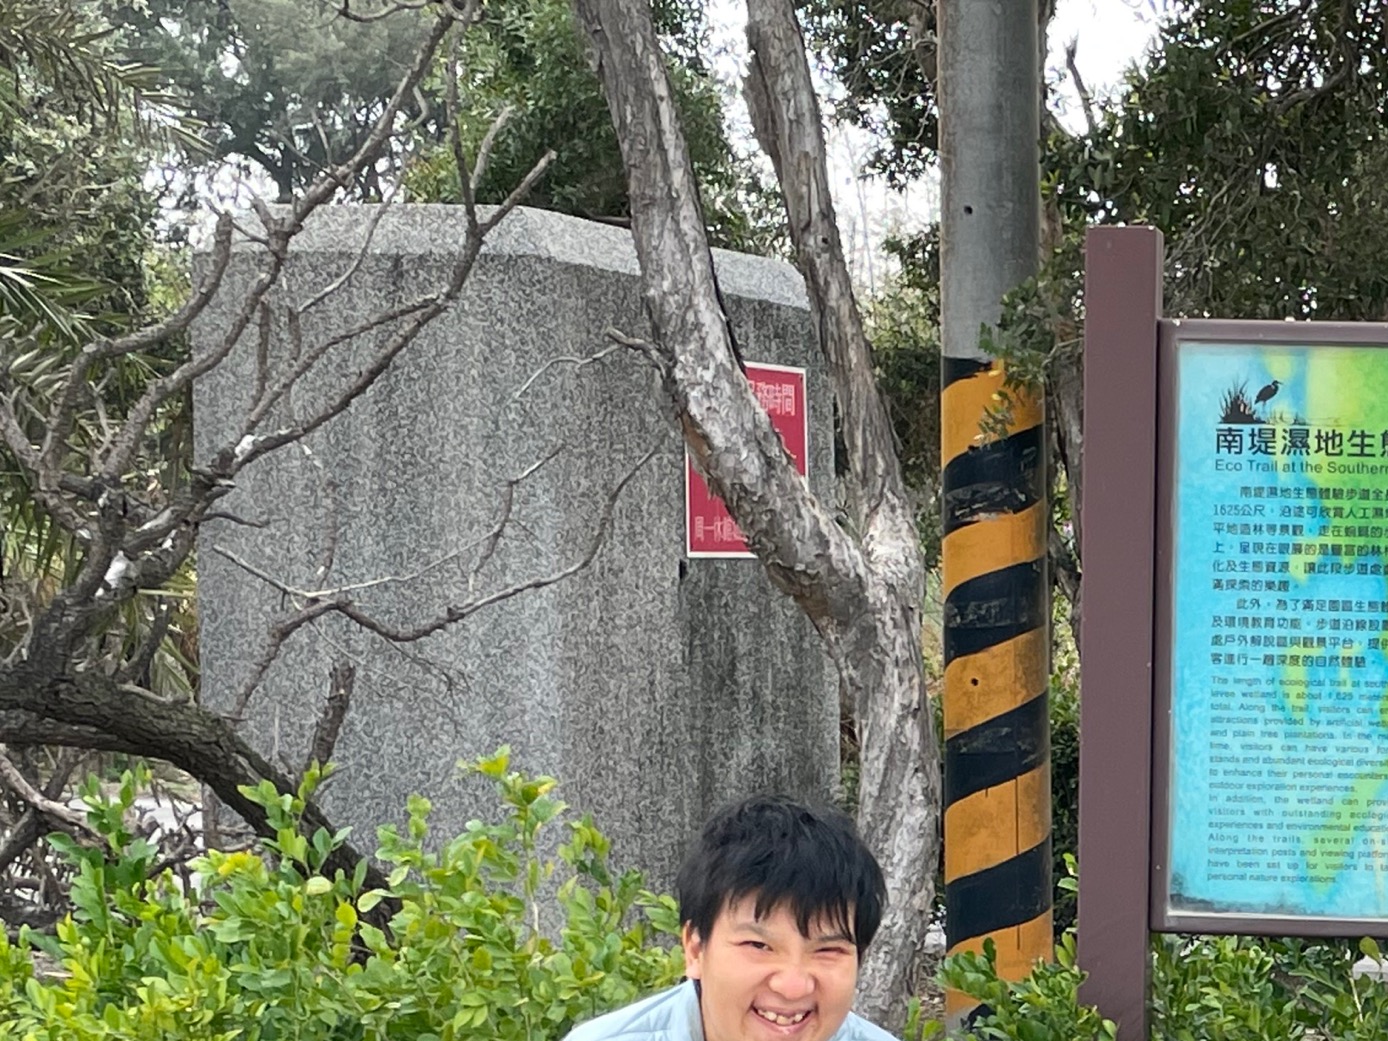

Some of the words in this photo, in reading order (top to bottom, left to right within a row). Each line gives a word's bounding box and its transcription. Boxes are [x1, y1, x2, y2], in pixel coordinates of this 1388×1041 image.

[1215, 458, 1242, 472] Eco
[1247, 459, 1278, 473] Trail
[1282, 460, 1297, 473] at
[1300, 460, 1323, 473] the
